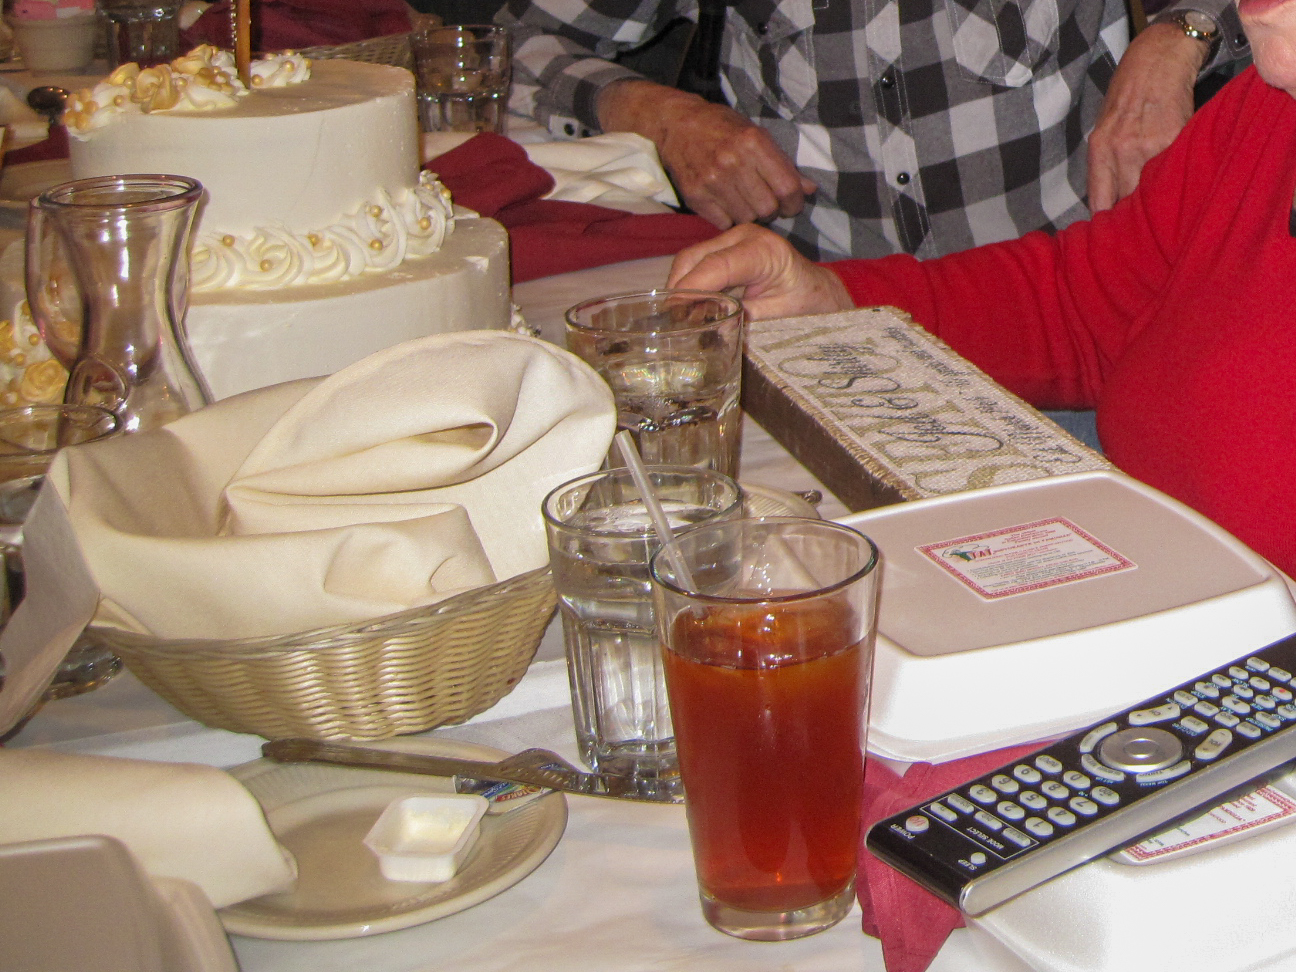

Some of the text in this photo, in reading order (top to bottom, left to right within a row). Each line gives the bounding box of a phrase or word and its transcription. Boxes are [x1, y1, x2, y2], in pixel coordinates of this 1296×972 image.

[806, 343, 901, 391] Shirley
[850, 396, 919, 409] &
[890, 823, 916, 839] POWER
